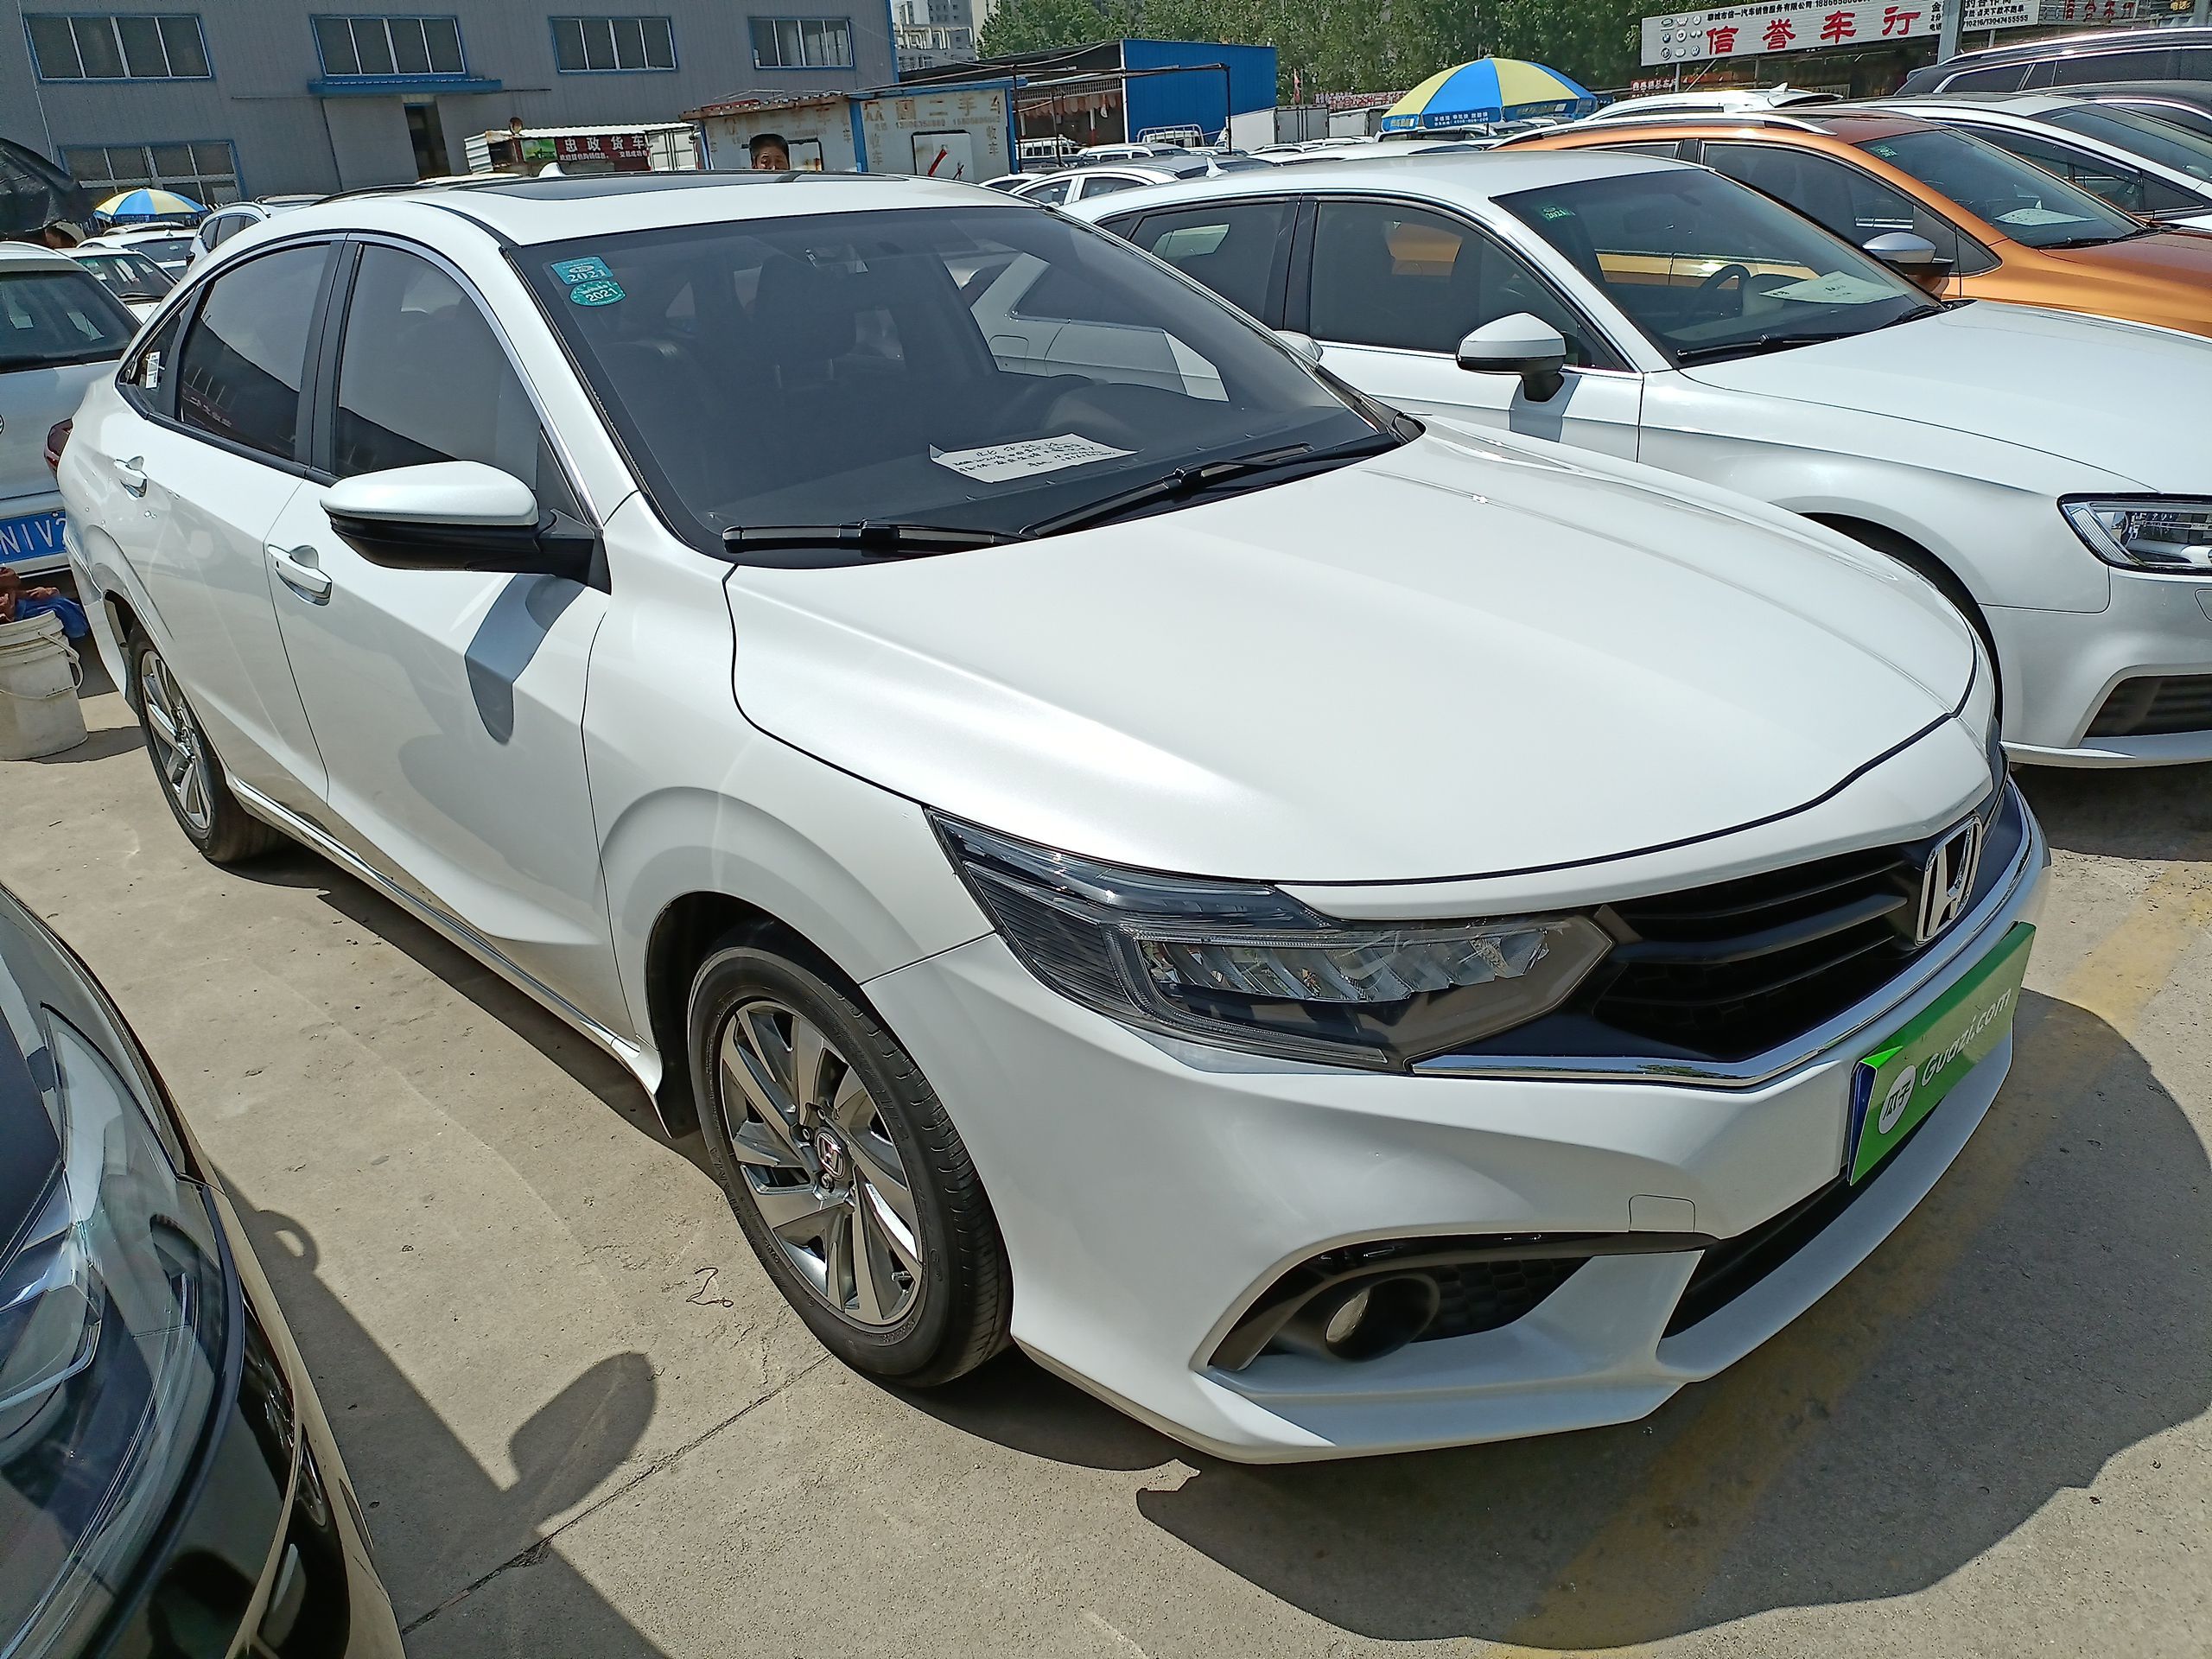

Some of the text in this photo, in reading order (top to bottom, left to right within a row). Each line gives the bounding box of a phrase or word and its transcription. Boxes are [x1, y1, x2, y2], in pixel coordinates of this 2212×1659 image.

[1707, 6, 1922, 54] 信誉车行
[567, 270, 607, 283] 2021
[586, 288, 617, 302] 2021
[1881, 988, 2012, 1122] 瓜子 Guazi.com
